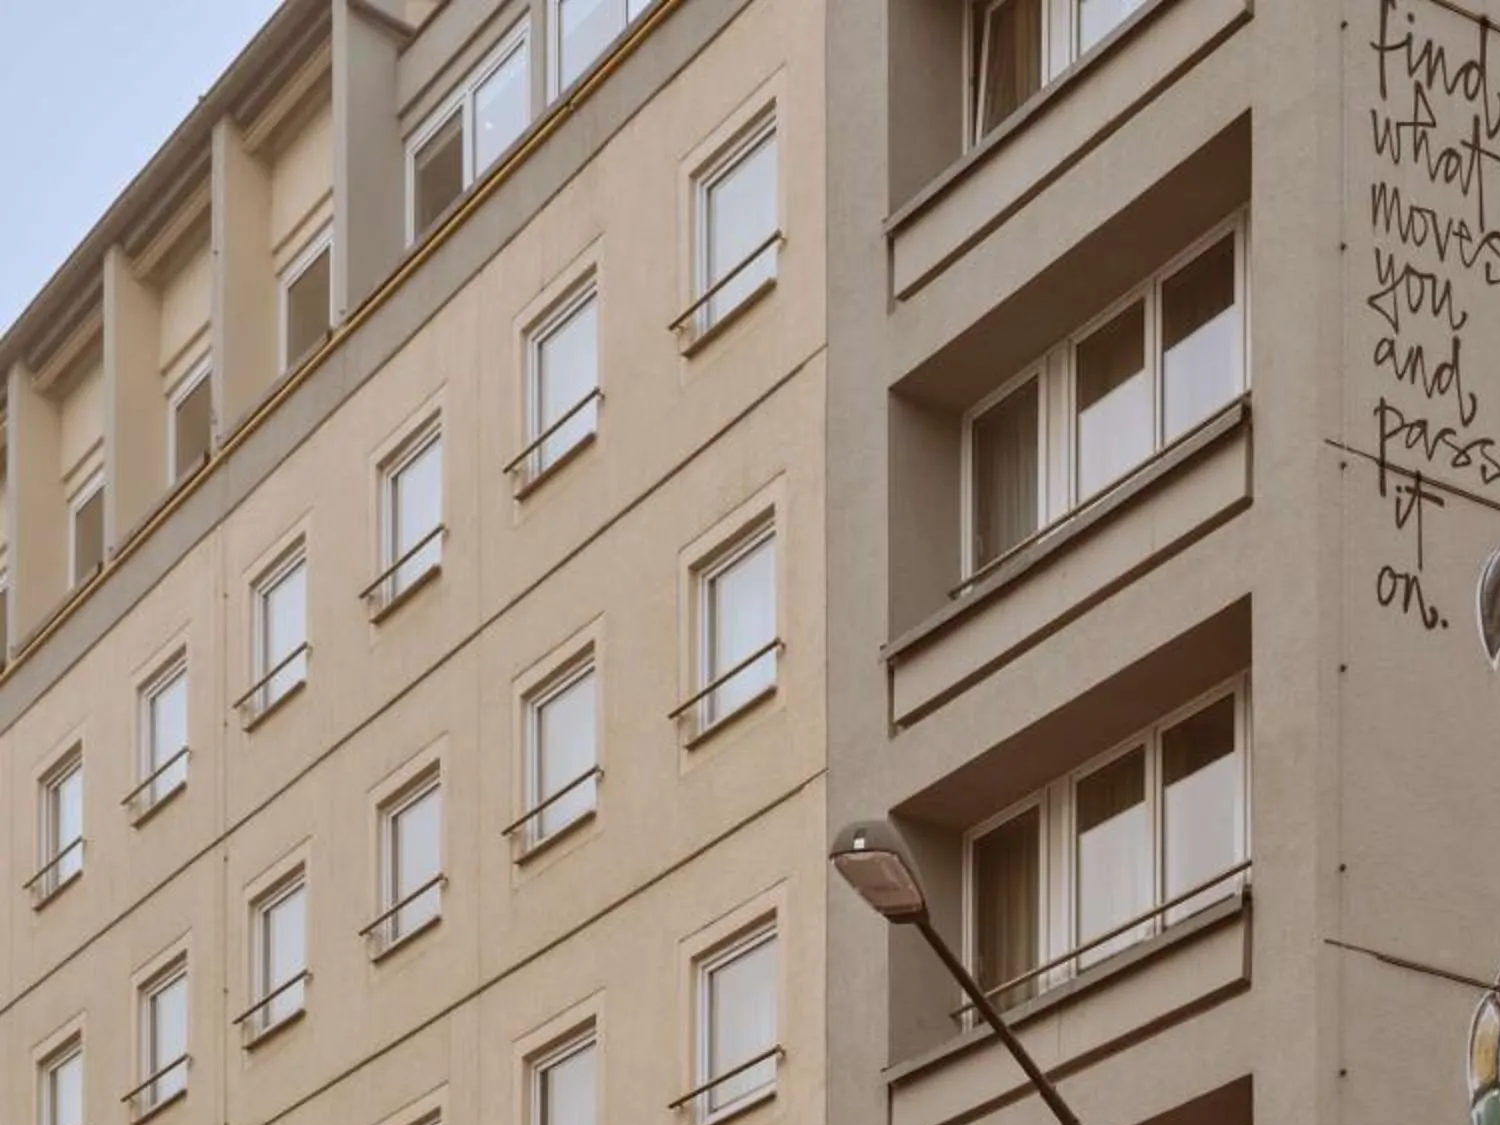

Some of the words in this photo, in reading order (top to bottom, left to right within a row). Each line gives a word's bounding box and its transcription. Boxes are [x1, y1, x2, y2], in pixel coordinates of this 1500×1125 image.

[1366, 247, 1468, 334] you
[1373, 334, 1478, 428] and
[1395, 470, 1445, 572] it
